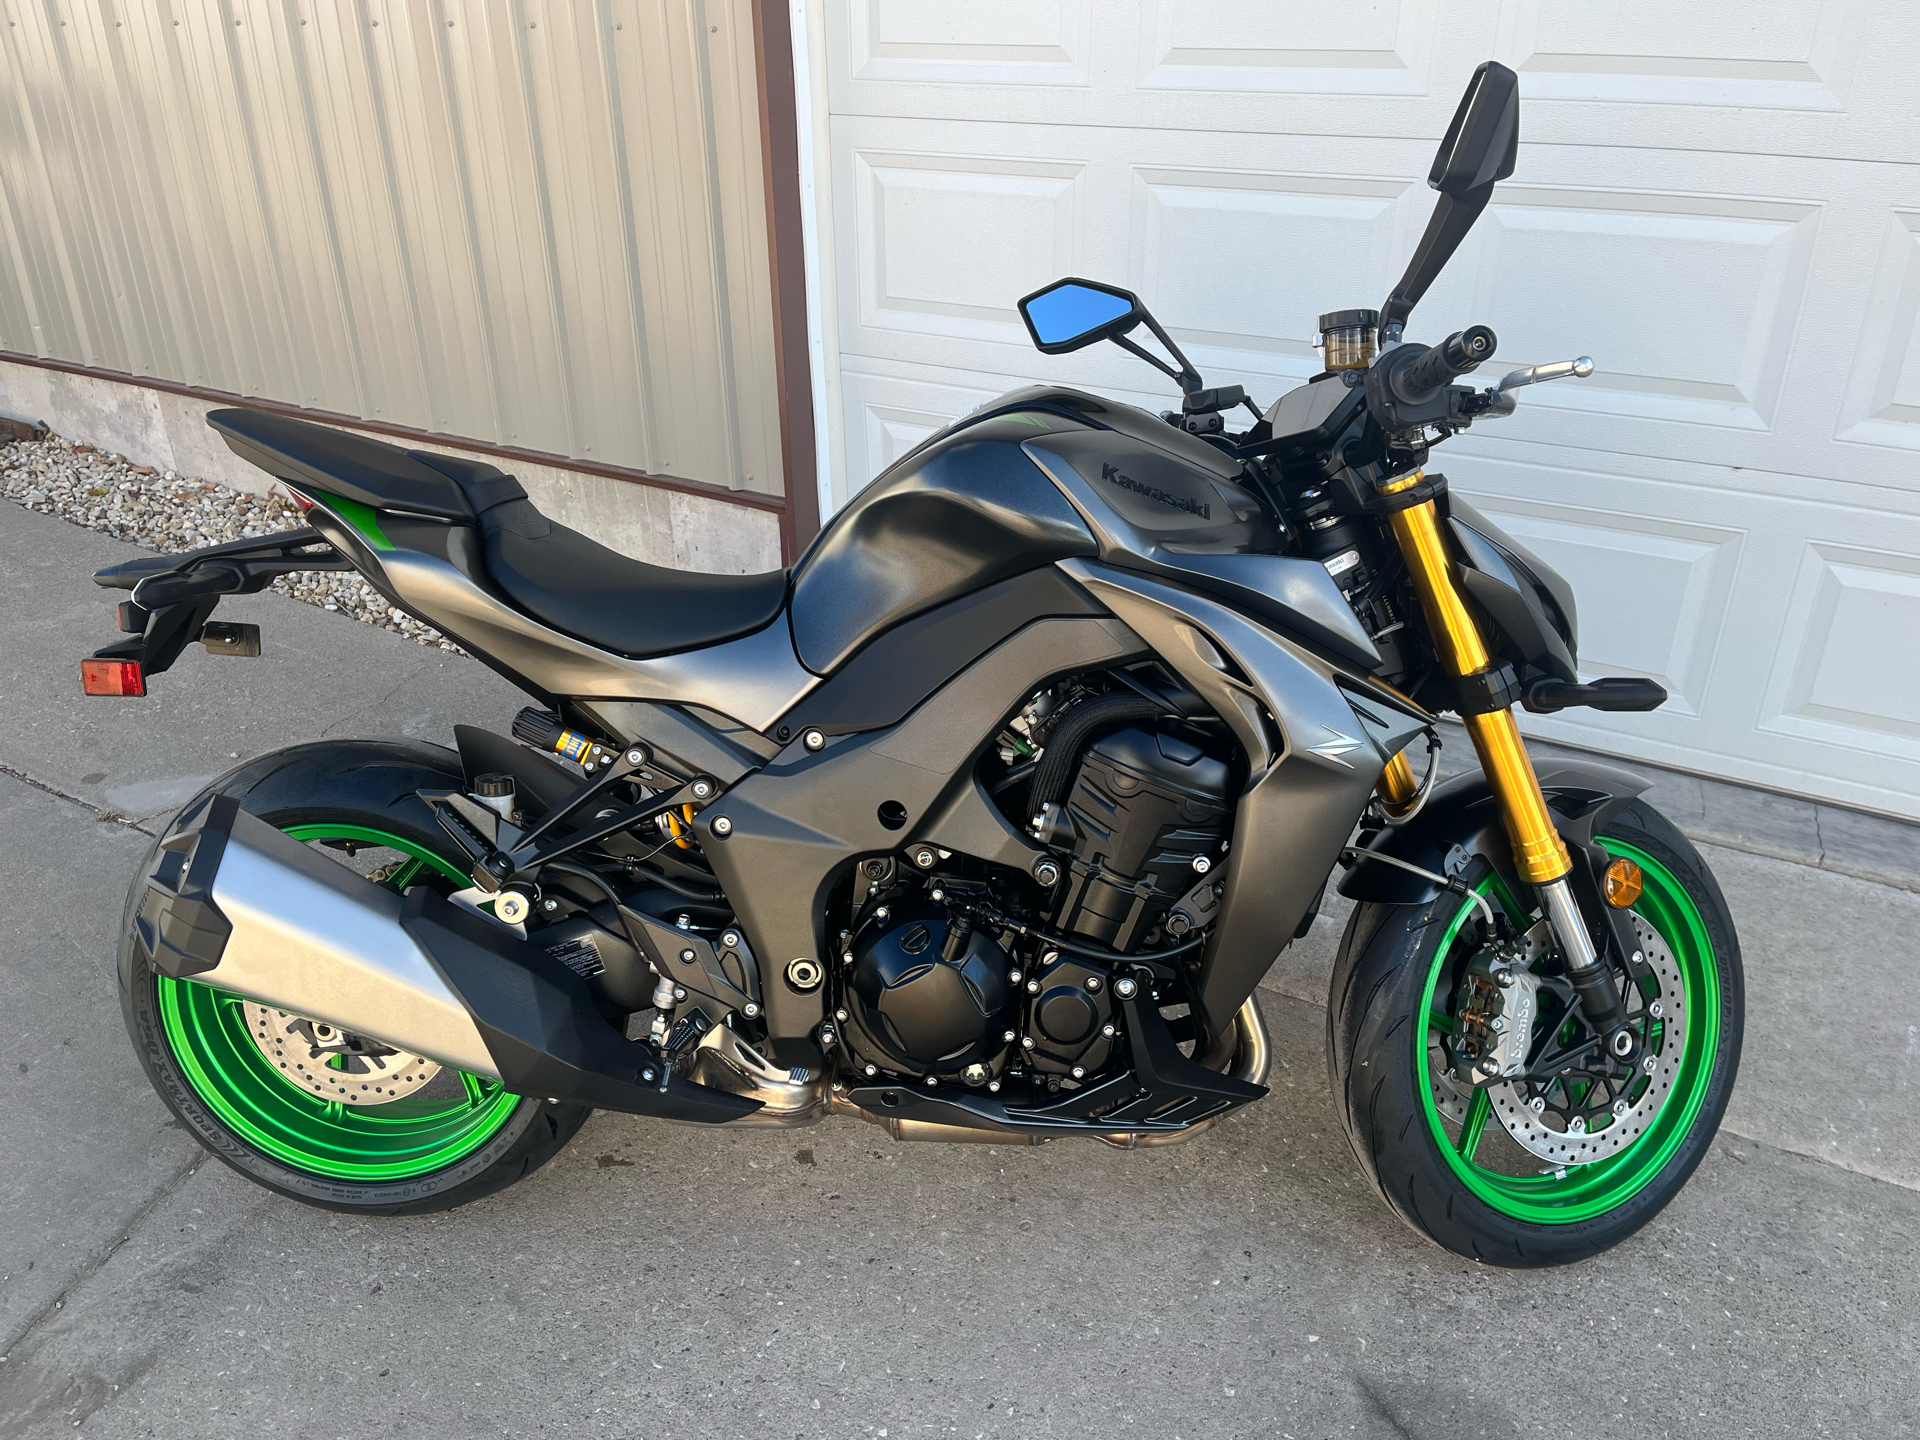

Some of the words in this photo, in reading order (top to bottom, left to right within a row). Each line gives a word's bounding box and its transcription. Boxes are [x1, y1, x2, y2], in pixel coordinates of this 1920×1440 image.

[1101, 461, 1211, 521] Kawasaki
[1720, 957, 1732, 1016] DUNLOP
[1510, 998, 1531, 1059] brembo
[155, 1061, 223, 1142] SPORTMAX
